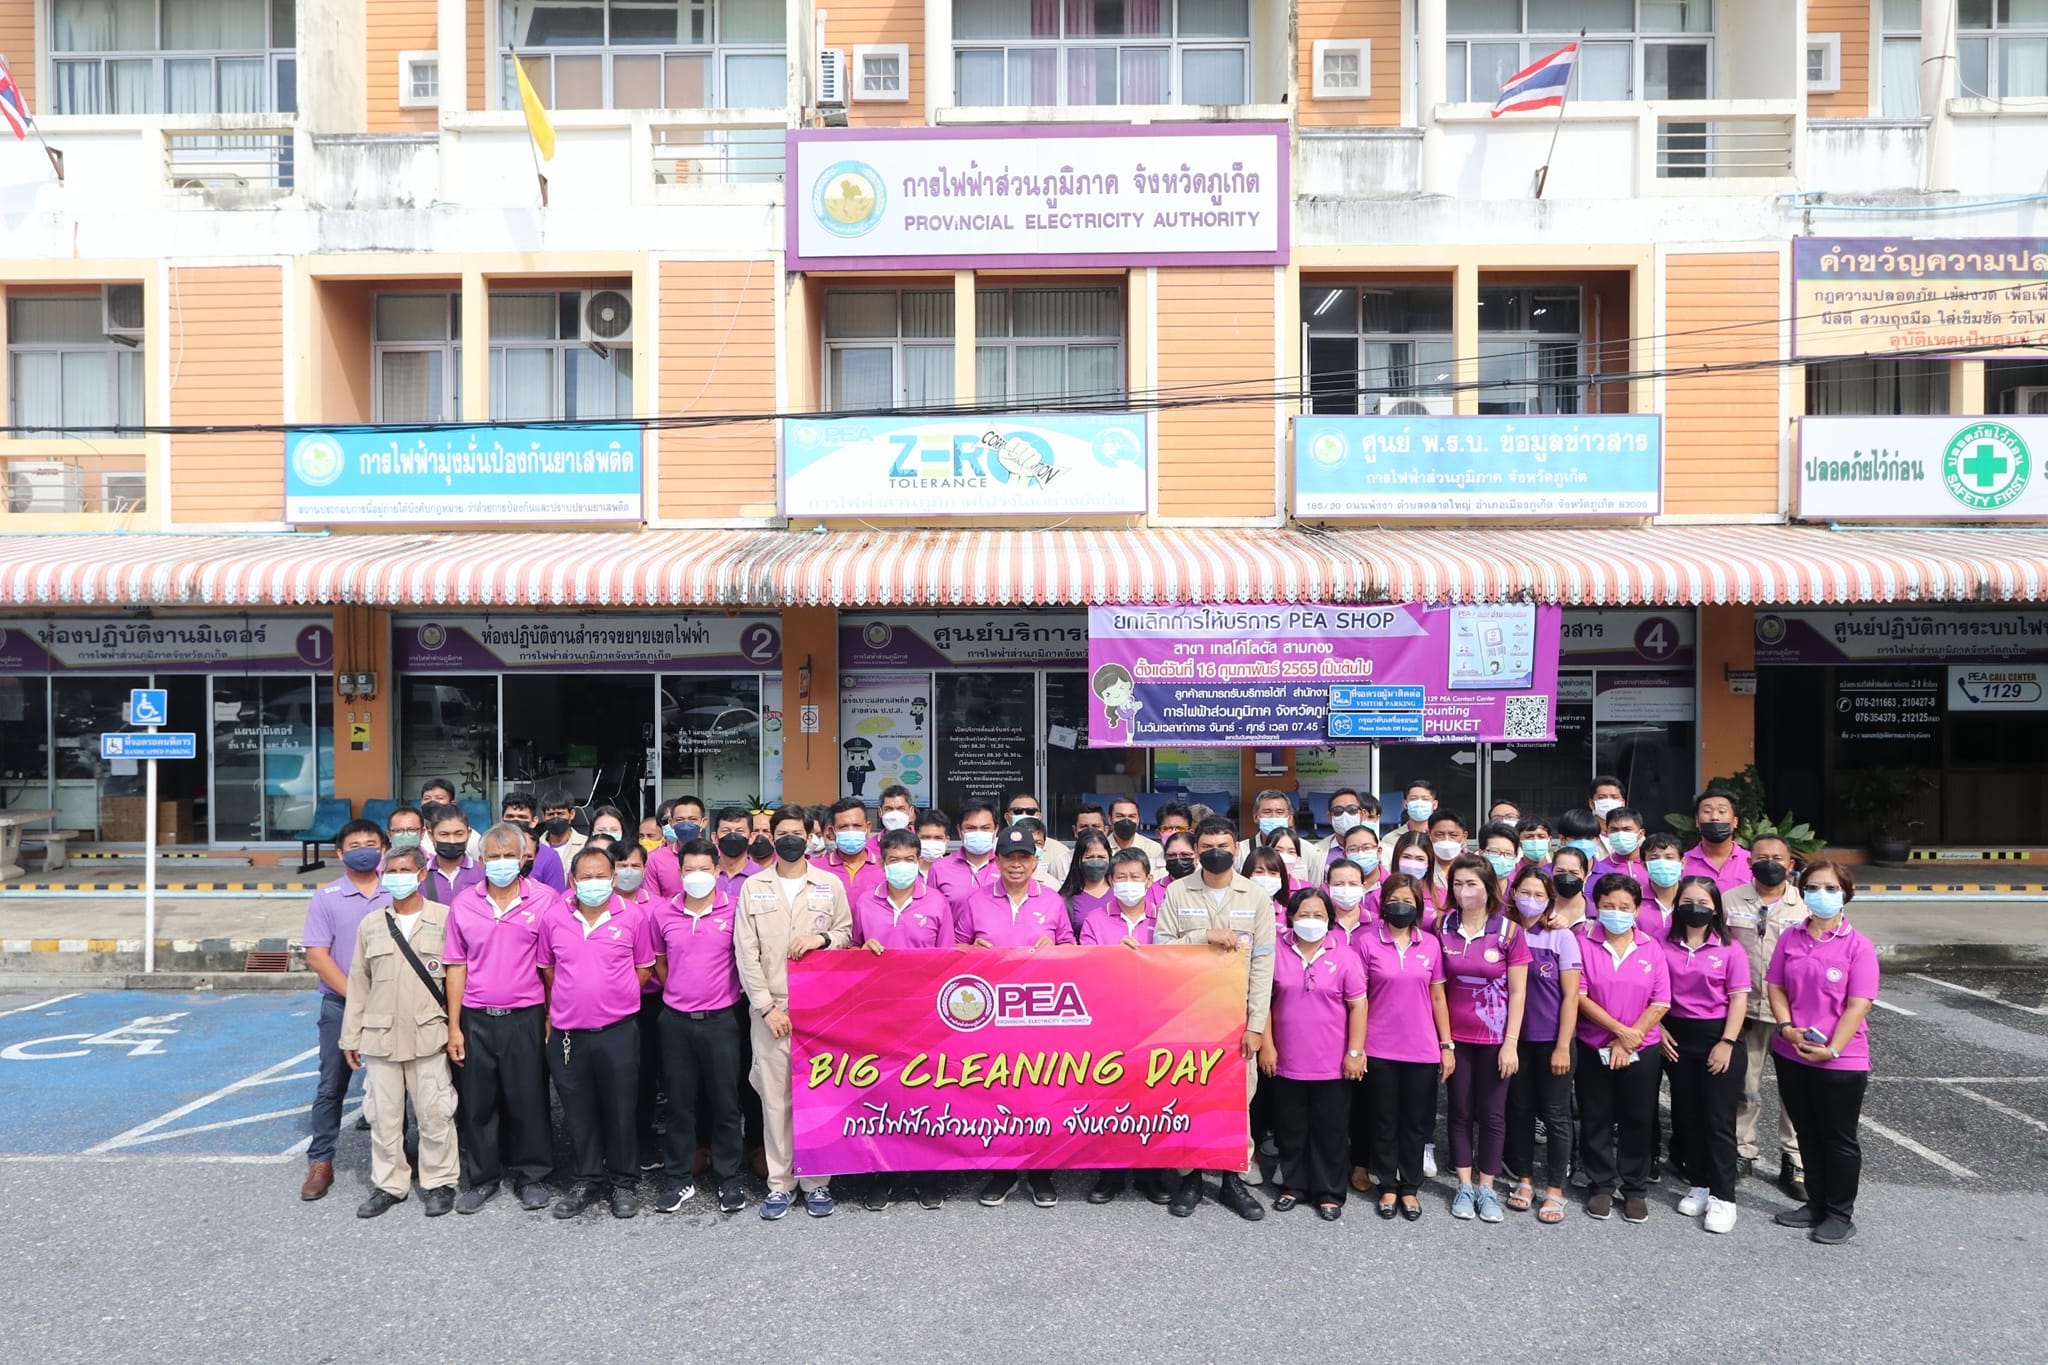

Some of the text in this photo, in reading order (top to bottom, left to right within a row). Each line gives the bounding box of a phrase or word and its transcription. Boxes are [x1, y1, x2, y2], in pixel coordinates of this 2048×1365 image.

[902, 160, 1261, 209] การไฟฟ้าส่วนภูมิภาค จังหวัดภูเก็ต
[1025, 212, 1144, 230] ELECTRICITY
[1153, 210, 1261, 229] AUTHORITY
[1362, 425, 1648, 463] ศูนย์ พ.ร.บ. ข้อมูลข่าวสาร
[1947, 425, 2024, 468] ปลอดภัยไว้ก่อน
[359, 435, 635, 486] การไฟฟ้ามุ่งมั่นป้องกันยาเสพติด
[1805, 448, 1924, 482] ปลอดภัยไว้ก่อน
[888, 477, 988, 489] TOLERANCE
[1366, 468, 1588, 489] การไฟฟ้าส่วนภูมิภาค จังหวัดภูเก็ต
[1947, 474, 2026, 507] SAFETY FIRST
[1113, 608, 1395, 630] ยกเลิกการให้บริการ PEA SHOP
[308, 630, 321, 659] 1
[481, 621, 773, 658] ห้องปฏิบัติงานสำรวจขยายเขตไฟฟ้า 2
[934, 622, 1088, 649] ศูนย์บริการ
[1174, 640, 1333, 655] สาขา เทสโก้โลตัส สามกอง
[1643, 623, 1668, 654] 4
[1134, 657, 1373, 680] ตั้งแต่วันที่ 16 กุมภาพันธ์ 2565 เป็นต้นไป
[1968, 672, 2037, 681] PEA CALL CENTER
[1175, 686, 1287, 700] ลูกค้าสามารถรับบริการได้ที่
[1983, 684, 2022, 698] 1129
[1163, 704, 1271, 719] การไฟฟ้าส่วนภูมิภาค
[1425, 719, 1481, 731] PHUKET
[1136, 721, 1206, 733] ในวันเวลาทำการ
[1209, 721, 1235, 733] จันทร์
[1246, 721, 1266, 735] ศุกร์
[1269, 723, 1288, 732] เวลา
[1291, 723, 1319, 732] 07.45
[996, 984, 1086, 1018] PEA
[808, 1046, 1225, 1090] BIG CLEANING DAY
[842, 1098, 1191, 1148] การไฟฟ้าส่วนภูมิภาค จังหวัดภูเก็ต
